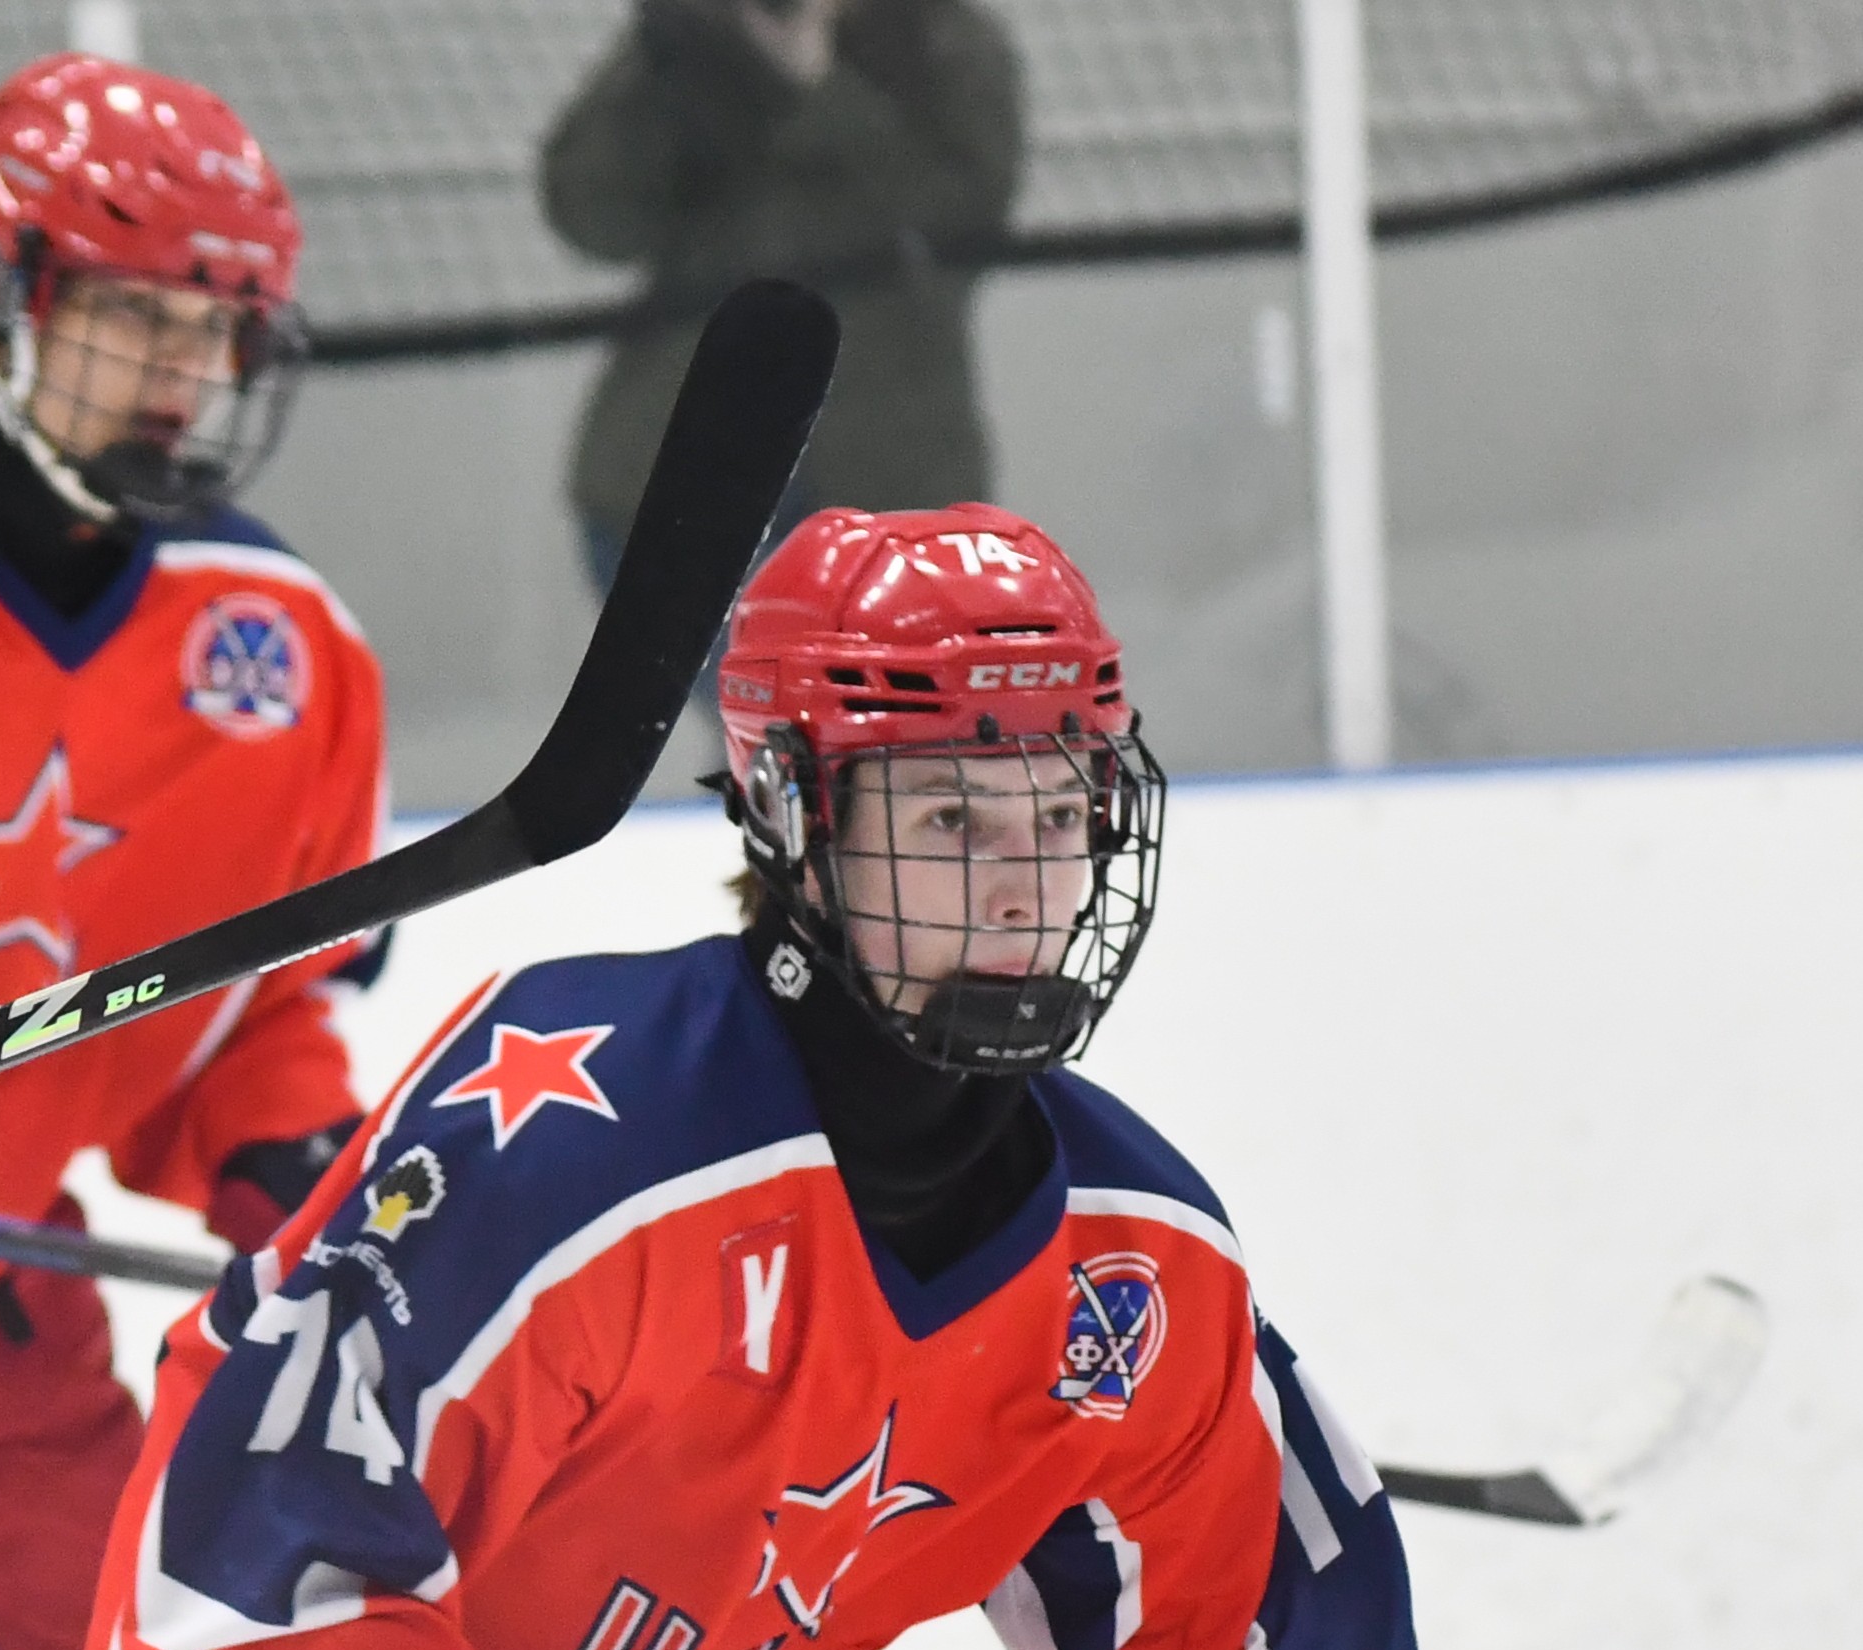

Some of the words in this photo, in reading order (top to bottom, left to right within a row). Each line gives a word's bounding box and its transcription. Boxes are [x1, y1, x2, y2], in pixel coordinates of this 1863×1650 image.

[938, 533, 1037, 576] 74
[968, 661, 1081, 690] CCM
[104, 974, 166, 1017] BC
[241, 1290, 405, 1486] 74
